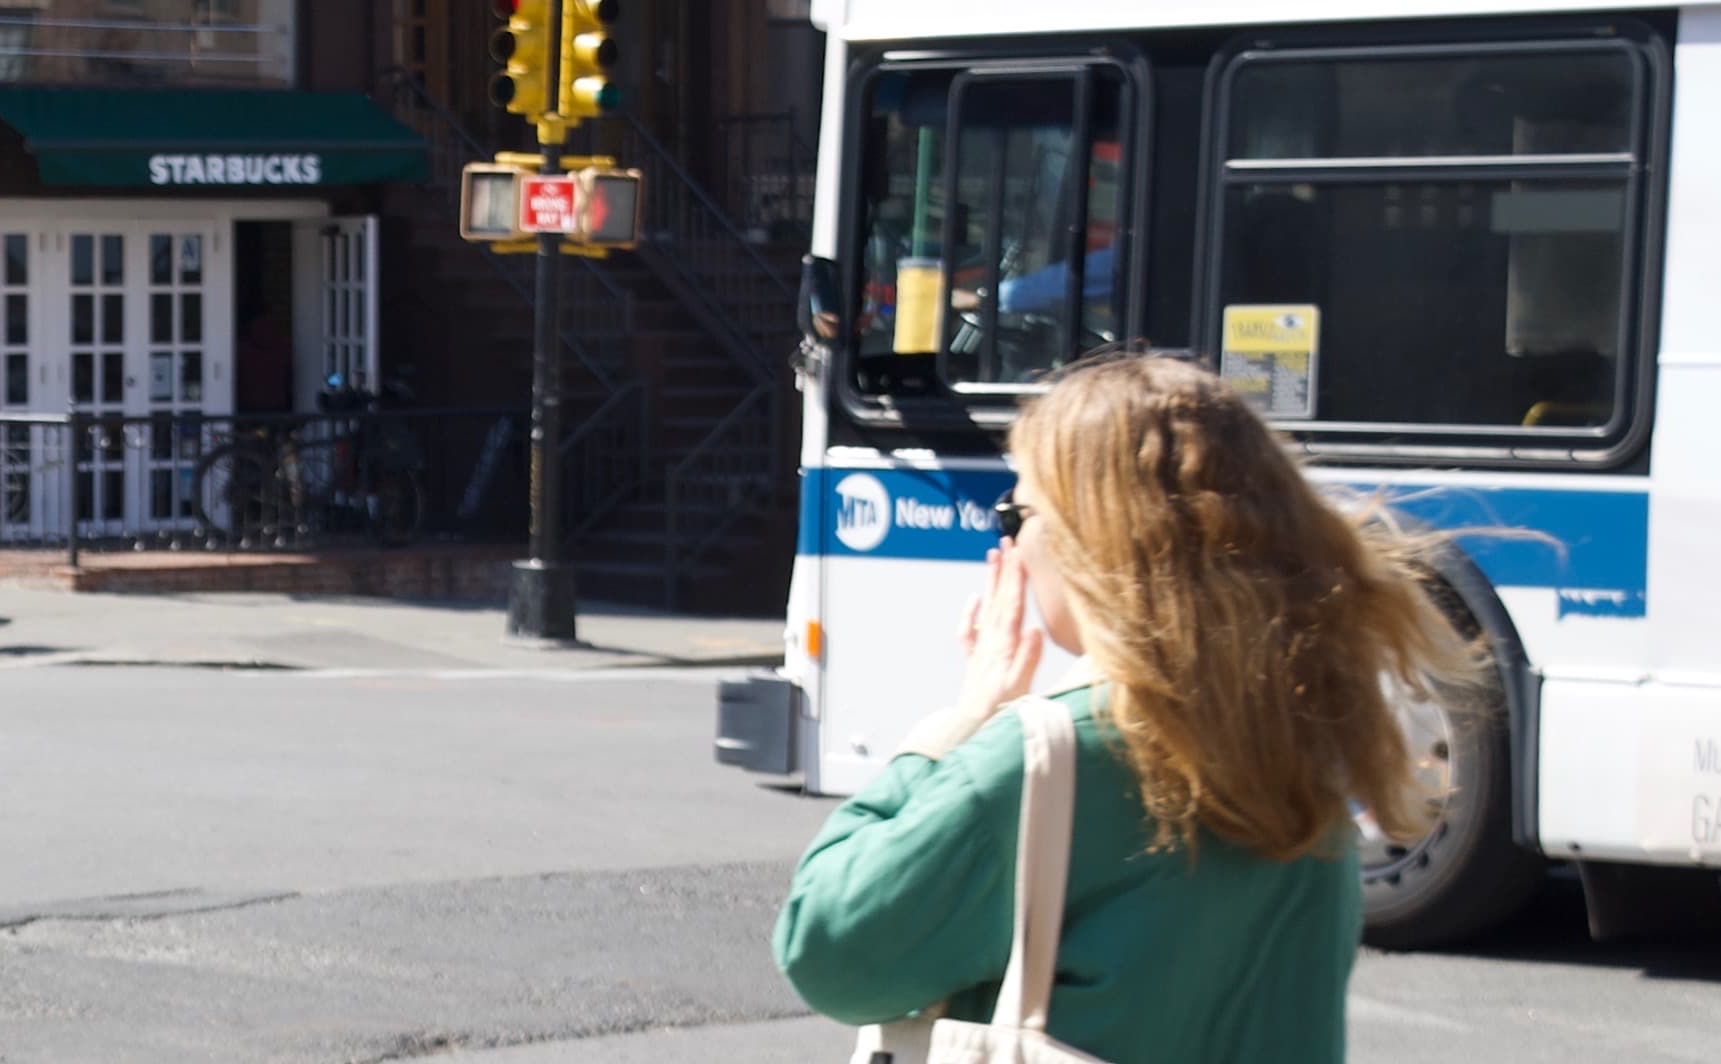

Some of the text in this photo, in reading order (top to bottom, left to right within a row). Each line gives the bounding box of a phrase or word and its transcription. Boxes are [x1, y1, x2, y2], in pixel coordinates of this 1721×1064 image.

[148, 153, 321, 185] STARBUCKS
[836, 495, 999, 532] MTA New Yor
